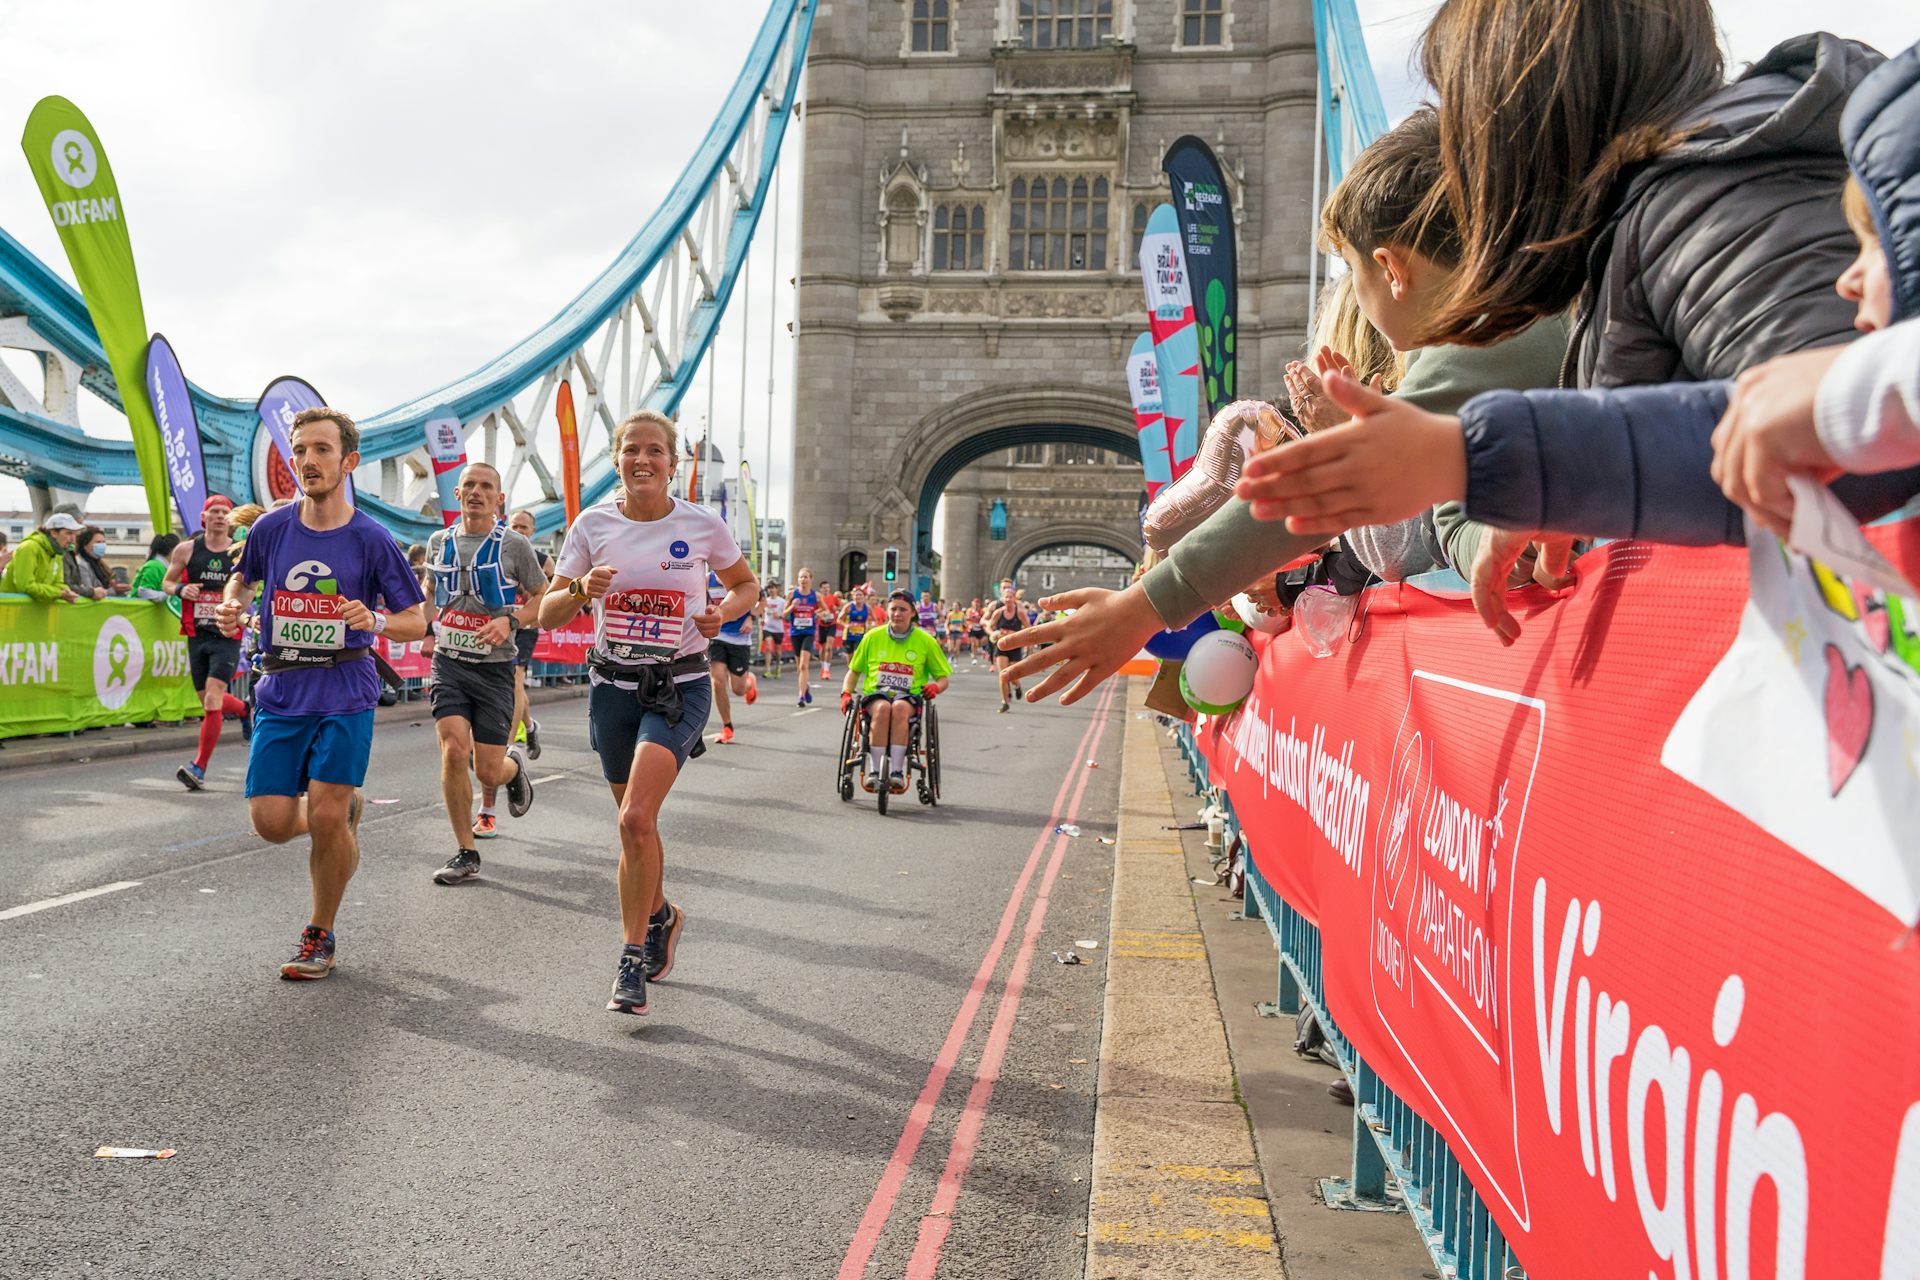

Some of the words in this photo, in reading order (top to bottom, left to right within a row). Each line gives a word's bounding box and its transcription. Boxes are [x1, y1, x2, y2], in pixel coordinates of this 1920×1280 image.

[1195, 192, 1222, 205] RESEARCH
[52, 196, 118, 227] OXFAM
[1187, 223, 1197, 233] LIFE
[1188, 234, 1198, 244] LIFE
[1157, 249, 1179, 269] BRAIN
[1188, 245, 1211, 255] RESEARCH
[1156, 270, 1183, 285] TUMOUR
[200, 571, 228, 581] ARMY
[277, 596, 341, 614] MONEY
[617, 596, 672, 618] Susan
[280, 622, 336, 644] 46022
[626, 617, 661, 640] 714
[0, 641, 58, 685] XFAM
[880, 674, 909, 687] 25208
[1269, 708, 1308, 811] London
[1308, 723, 1370, 878] Marathon
[1423, 786, 1483, 894] LONDON
[1377, 917, 1405, 992] MONEY
[1416, 870, 1498, 1029] MARATHON
[1532, 877, 1809, 1280] Virgin
